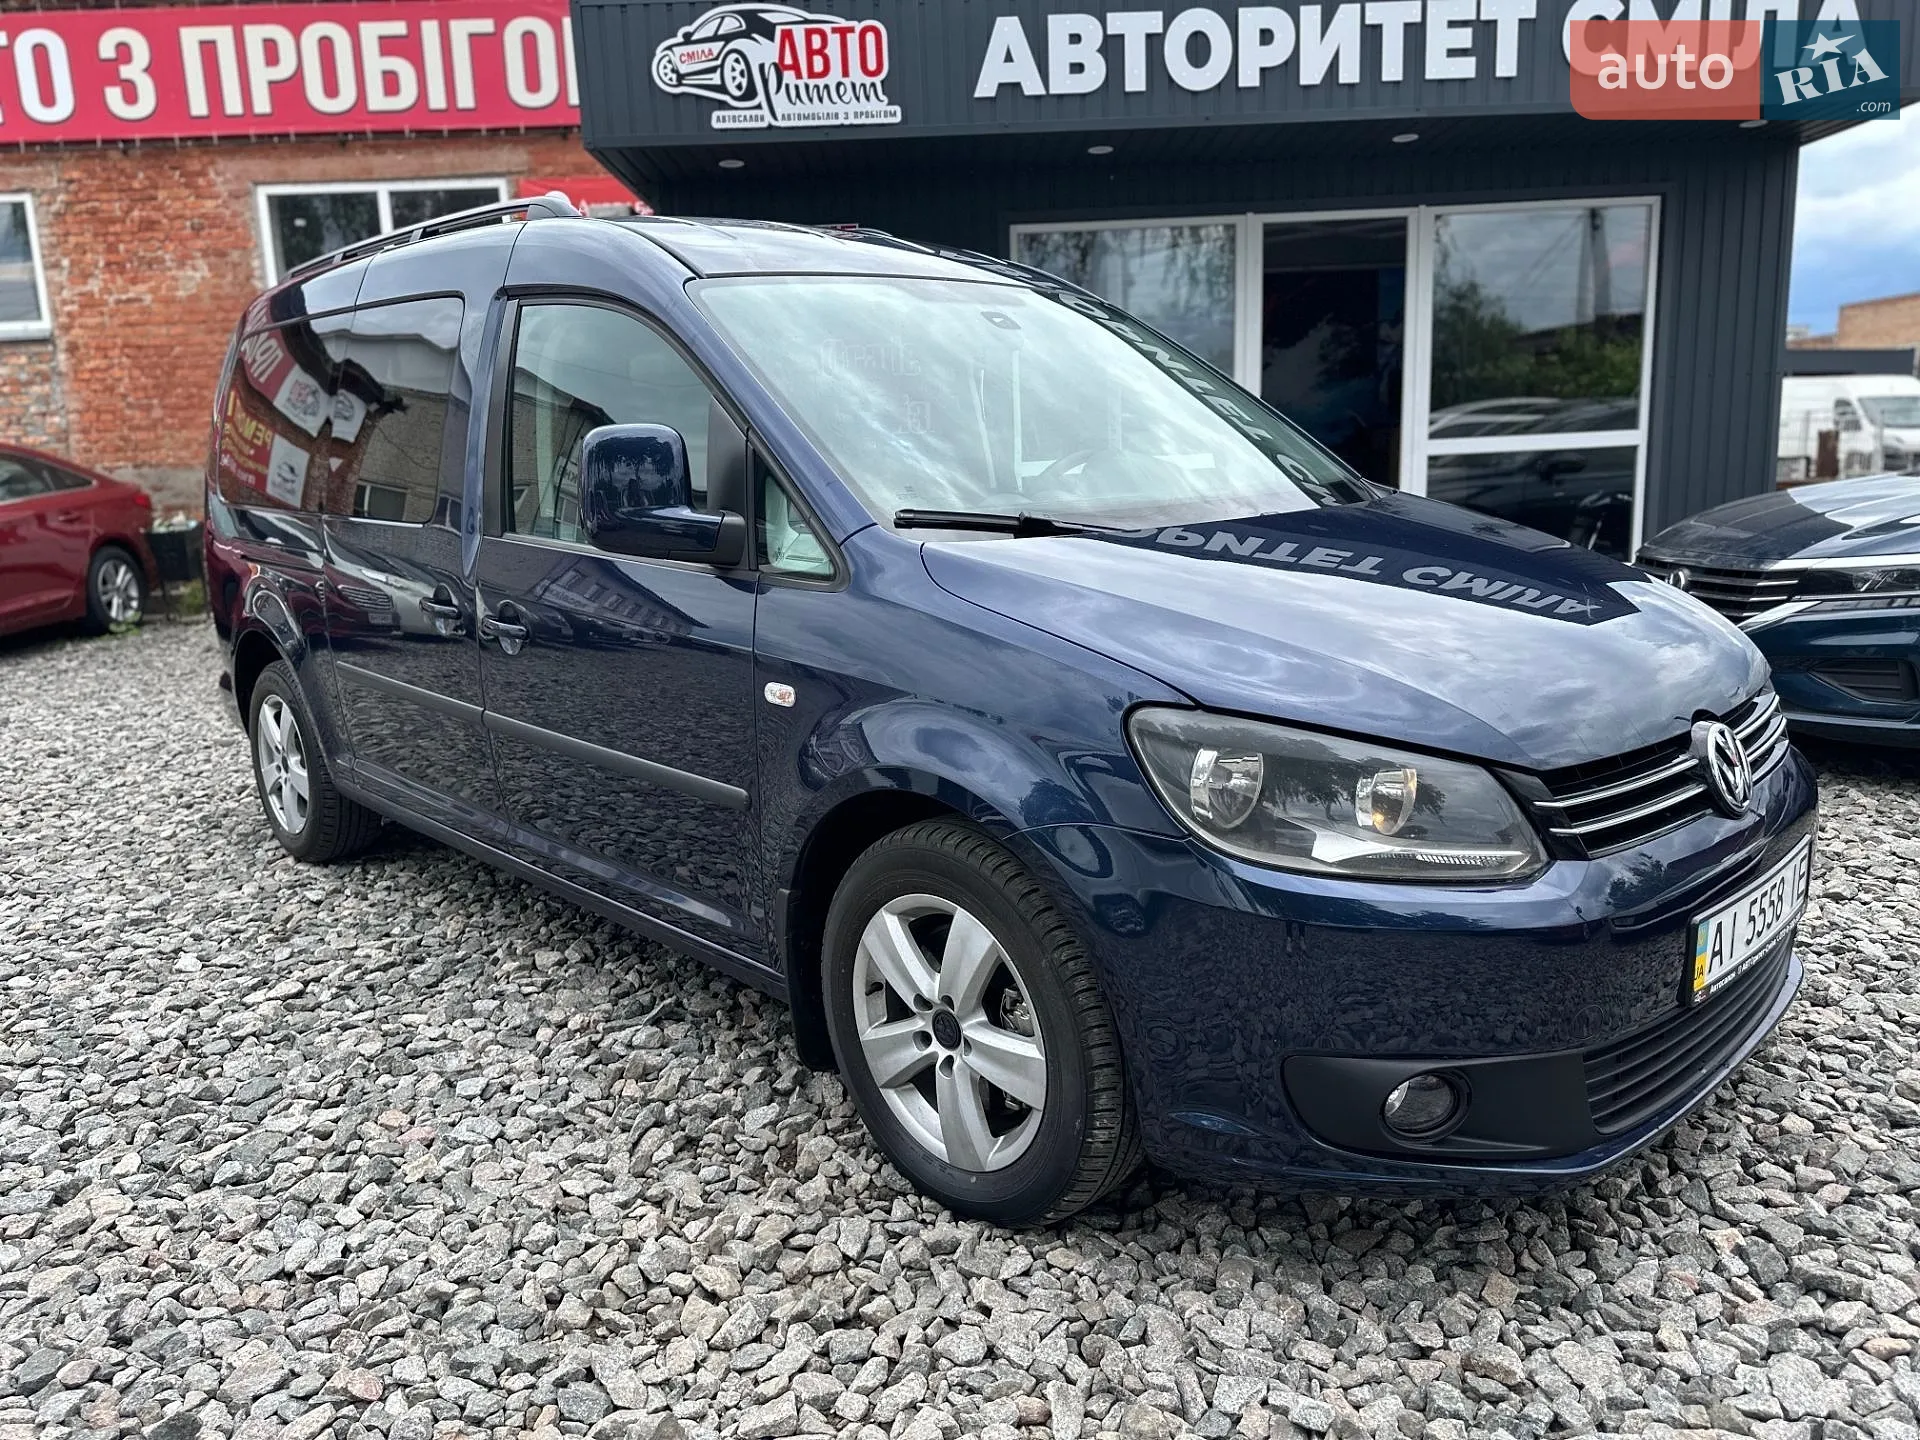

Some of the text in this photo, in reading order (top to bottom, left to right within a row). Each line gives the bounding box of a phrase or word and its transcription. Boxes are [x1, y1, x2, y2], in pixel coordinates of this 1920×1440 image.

[0, 28, 76, 124] О
[679, 48, 715, 64] СМІЛА
[777, 24, 885, 81] АВТО
[974, 0, 1538, 98] АВТОРИТЕТ
[1708, 911, 1737, 973] AI
[1745, 876, 1786, 946] 5558
